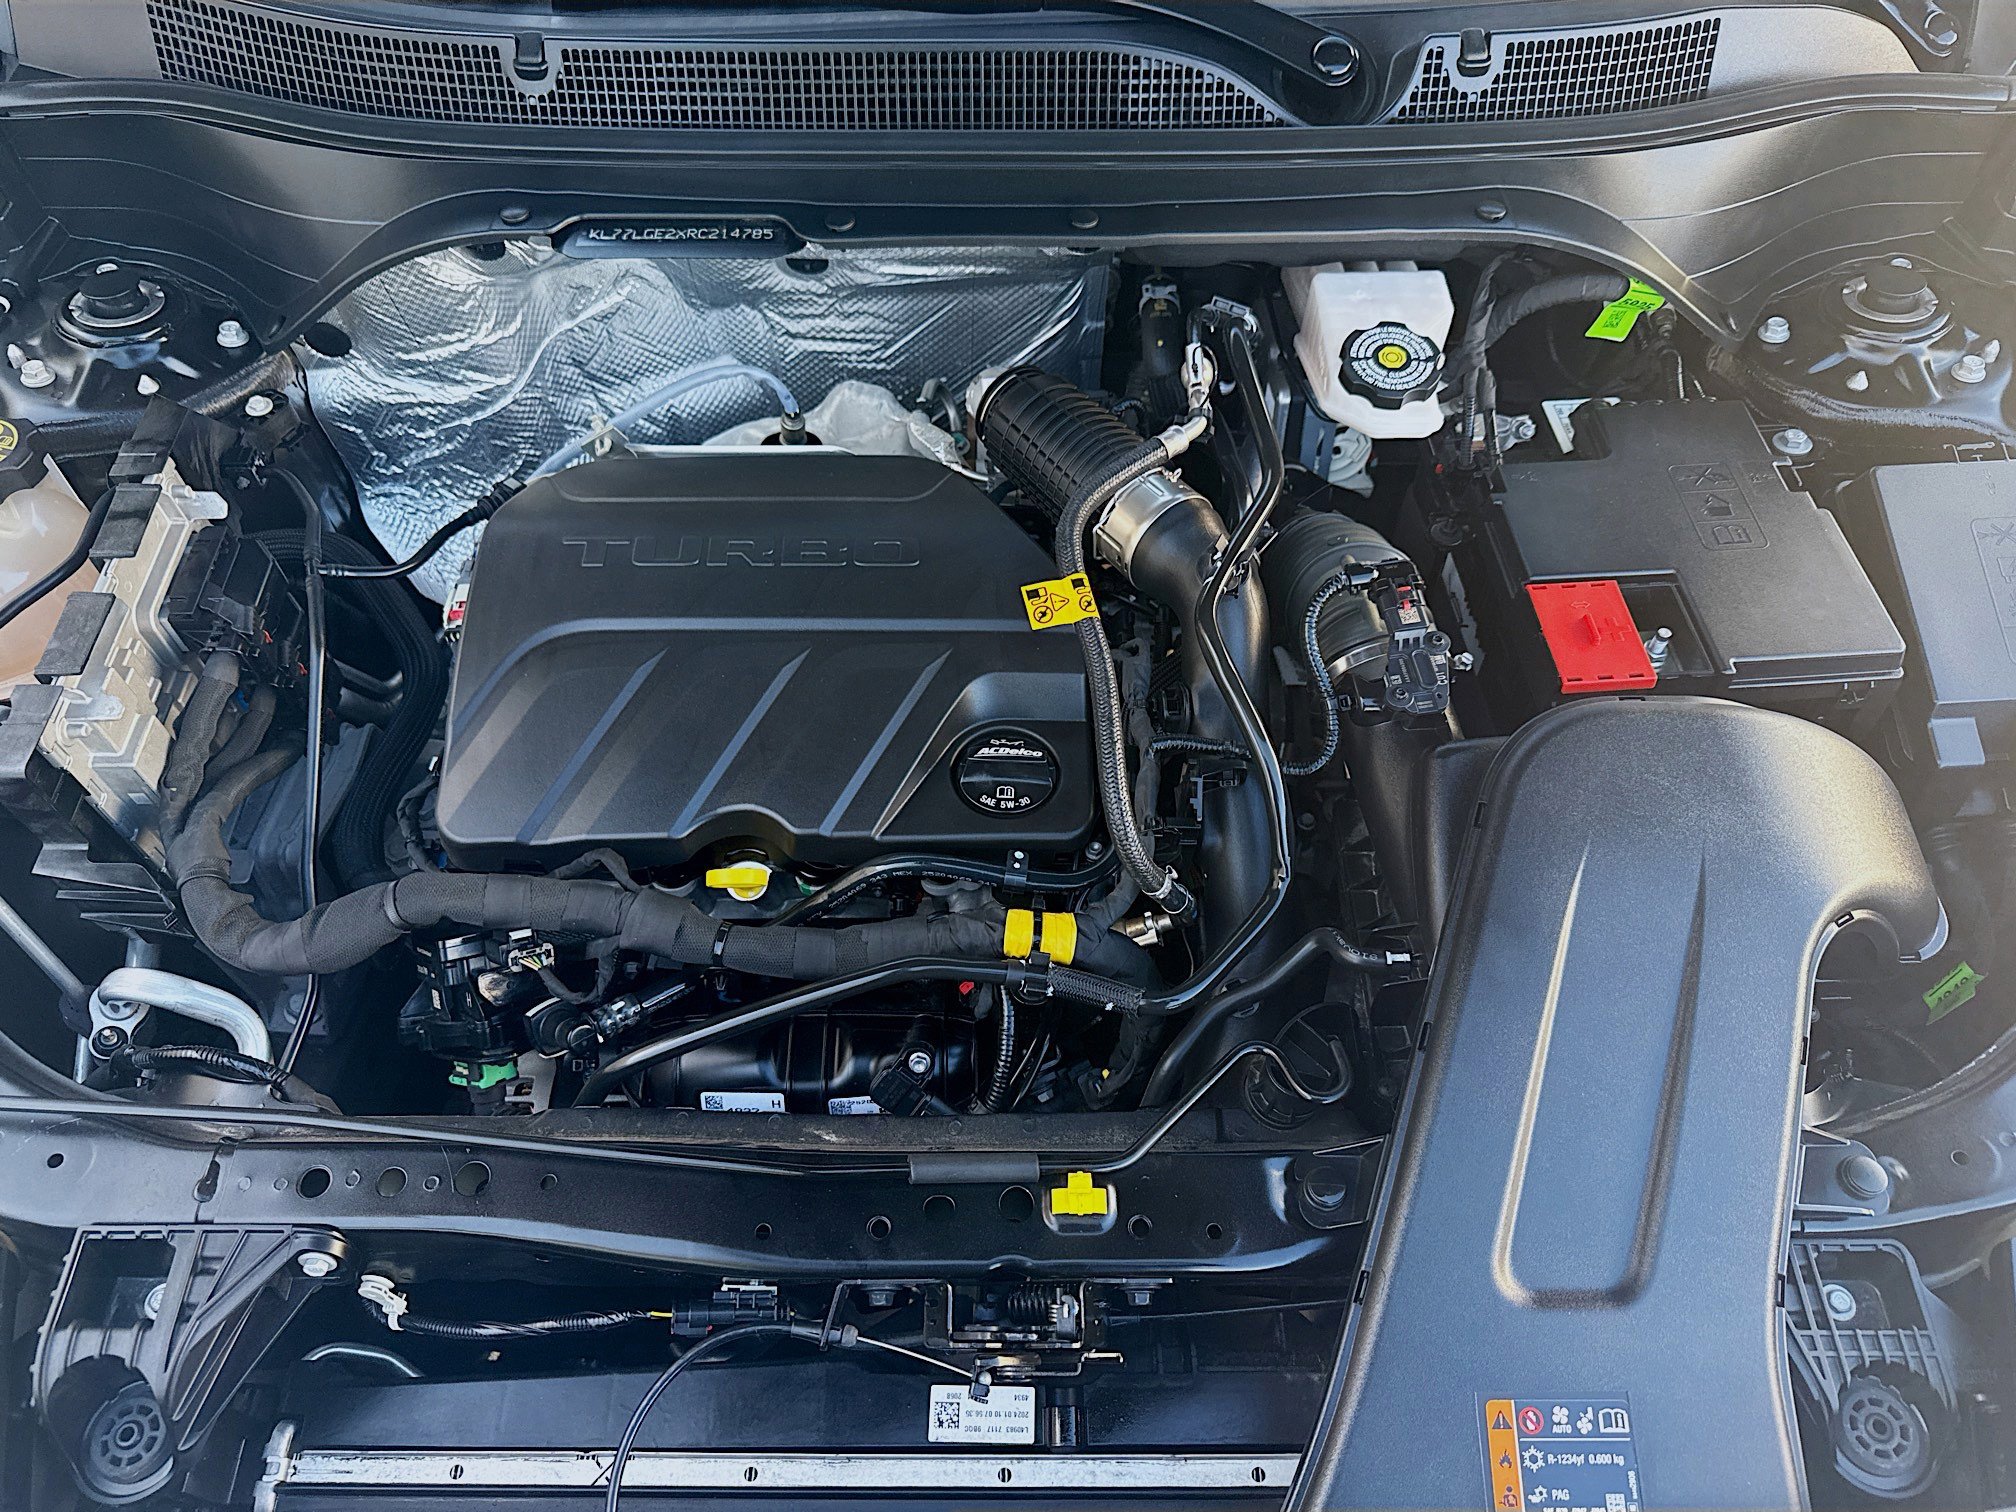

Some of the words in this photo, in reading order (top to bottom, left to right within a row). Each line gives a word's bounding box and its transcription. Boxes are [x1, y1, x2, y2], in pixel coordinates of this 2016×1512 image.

[561, 536, 920, 568] TURBO
[976, 747, 1043, 757] ACDelco
[980, 795, 997, 807] SAE
[1000, 796, 1031, 809] 5W-30
[771, 1099, 781, 1109] H
[1552, 1424, 1572, 1434] AUTO
[1547, 1453, 1585, 1467] R-1234yf
[1588, 1453, 1612, 1465] 0.600
[1613, 1453, 1625, 1467] kg
[1551, 1488, 1570, 1501] PAG
